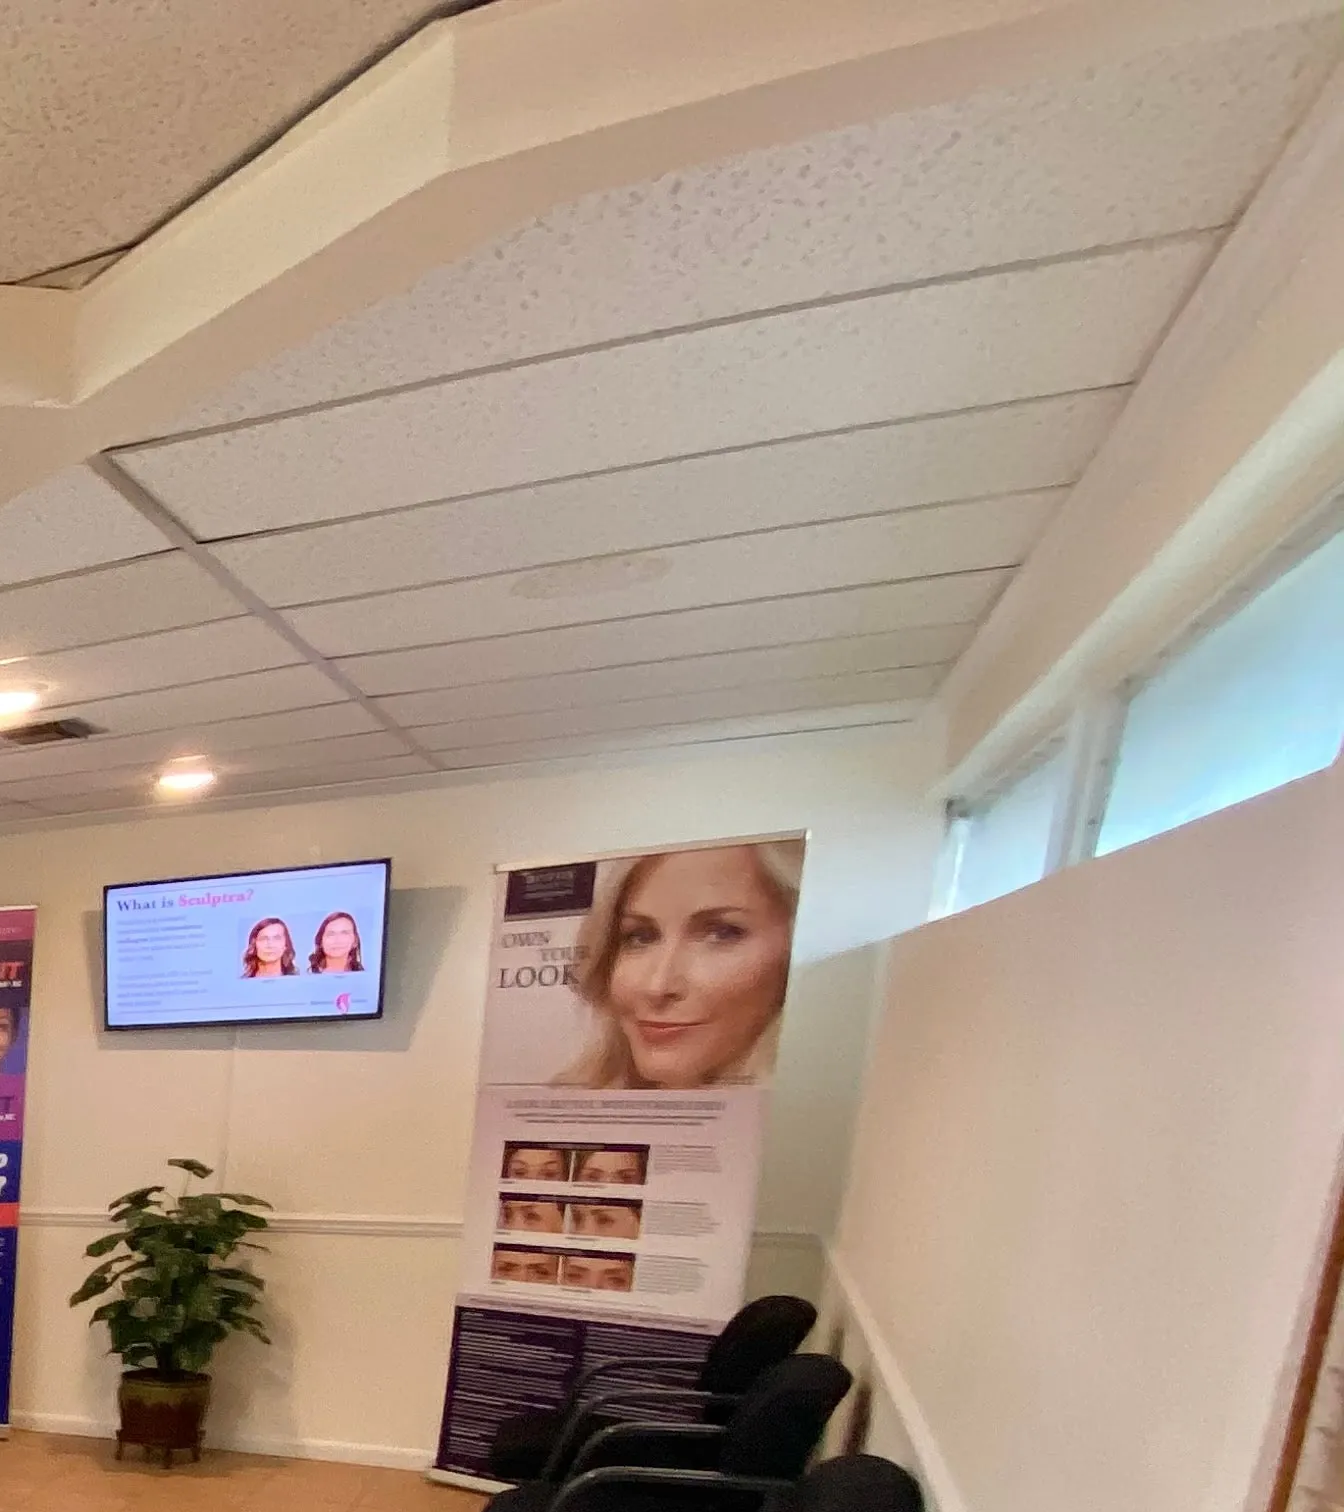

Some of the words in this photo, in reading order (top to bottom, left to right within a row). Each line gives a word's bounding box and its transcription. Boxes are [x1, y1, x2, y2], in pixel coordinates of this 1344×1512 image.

[117, 899, 157, 912] What
[161, 896, 175, 909] is
[178, 888, 255, 907] Sculptra?
[497, 963, 580, 989] LOOK
